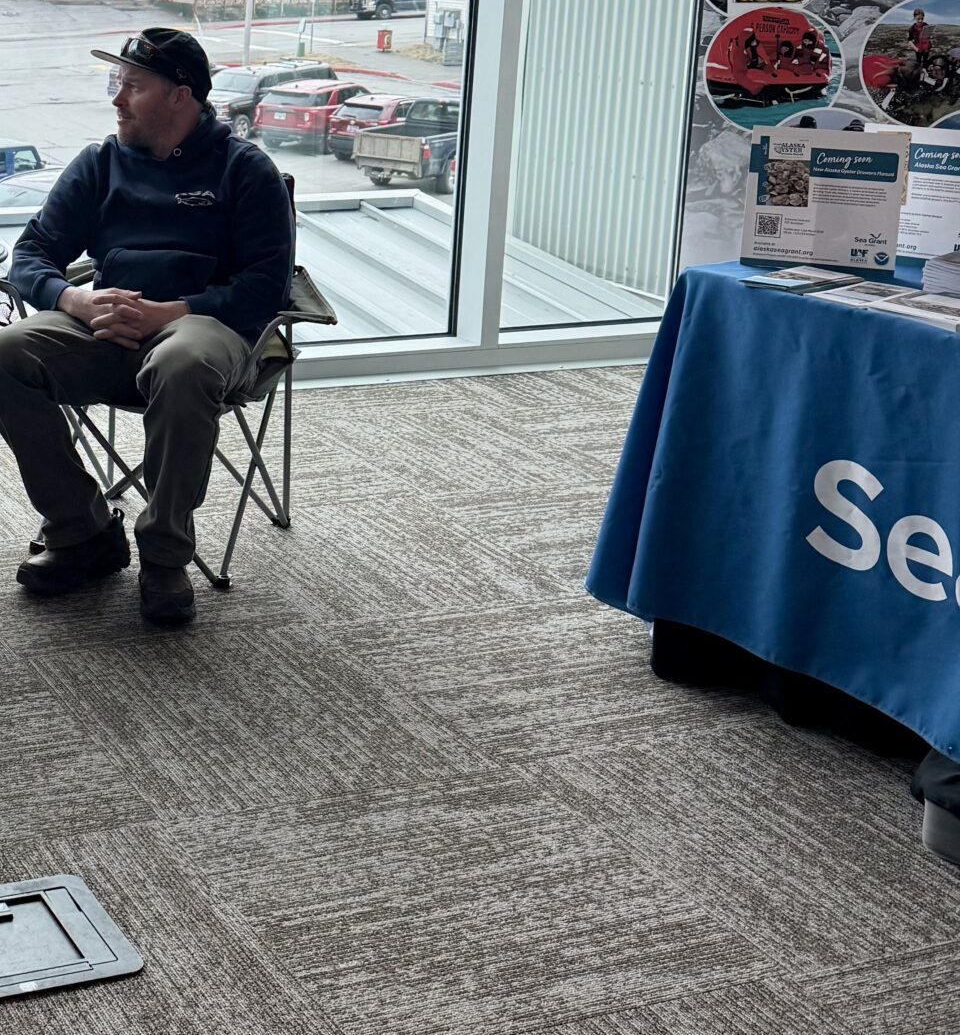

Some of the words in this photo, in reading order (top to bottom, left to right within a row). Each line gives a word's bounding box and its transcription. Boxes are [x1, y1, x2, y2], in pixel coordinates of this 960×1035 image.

[816, 152, 852, 169] Coming
[854, 156, 873, 164] soon
[914, 147, 950, 165] Coming
[914, 161, 935, 170] Alaska
[935, 163, 947, 171] Sea
[854, 236, 867, 244] Sea
[868, 237, 888, 246] Grant
[806, 459, 960, 607] Se
